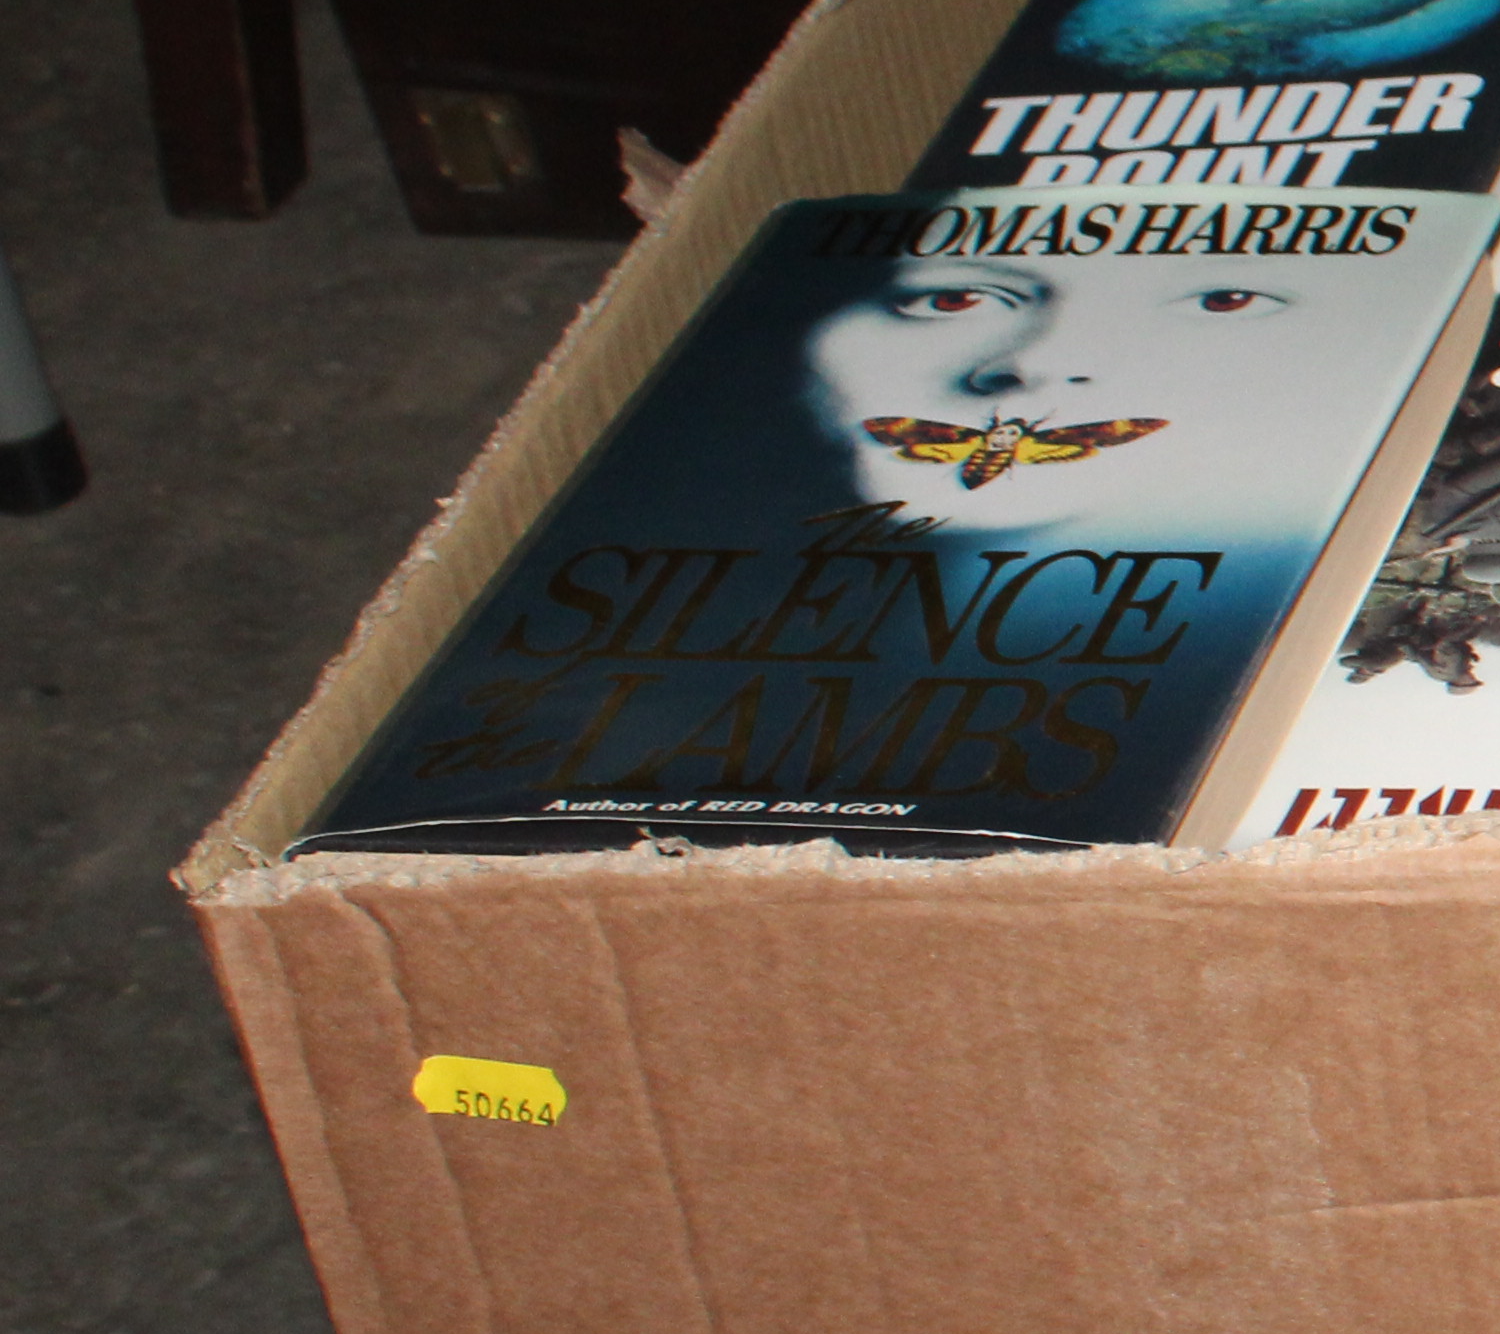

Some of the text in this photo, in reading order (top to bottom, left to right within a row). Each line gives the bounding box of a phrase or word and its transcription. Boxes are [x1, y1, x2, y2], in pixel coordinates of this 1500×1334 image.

[970, 73, 1485, 156] THUNDER
[1017, 139, 1377, 189] POINT
[814, 202, 1417, 258] THOMAS HARRIS
[802, 500, 952, 553] The
[496, 545, 1223, 666] SILENCE
[536, 673, 1152, 800] LAMBS
[544, 798, 917, 817] Author of RED DRAGON
[455, 1090, 555, 1126] 50664
